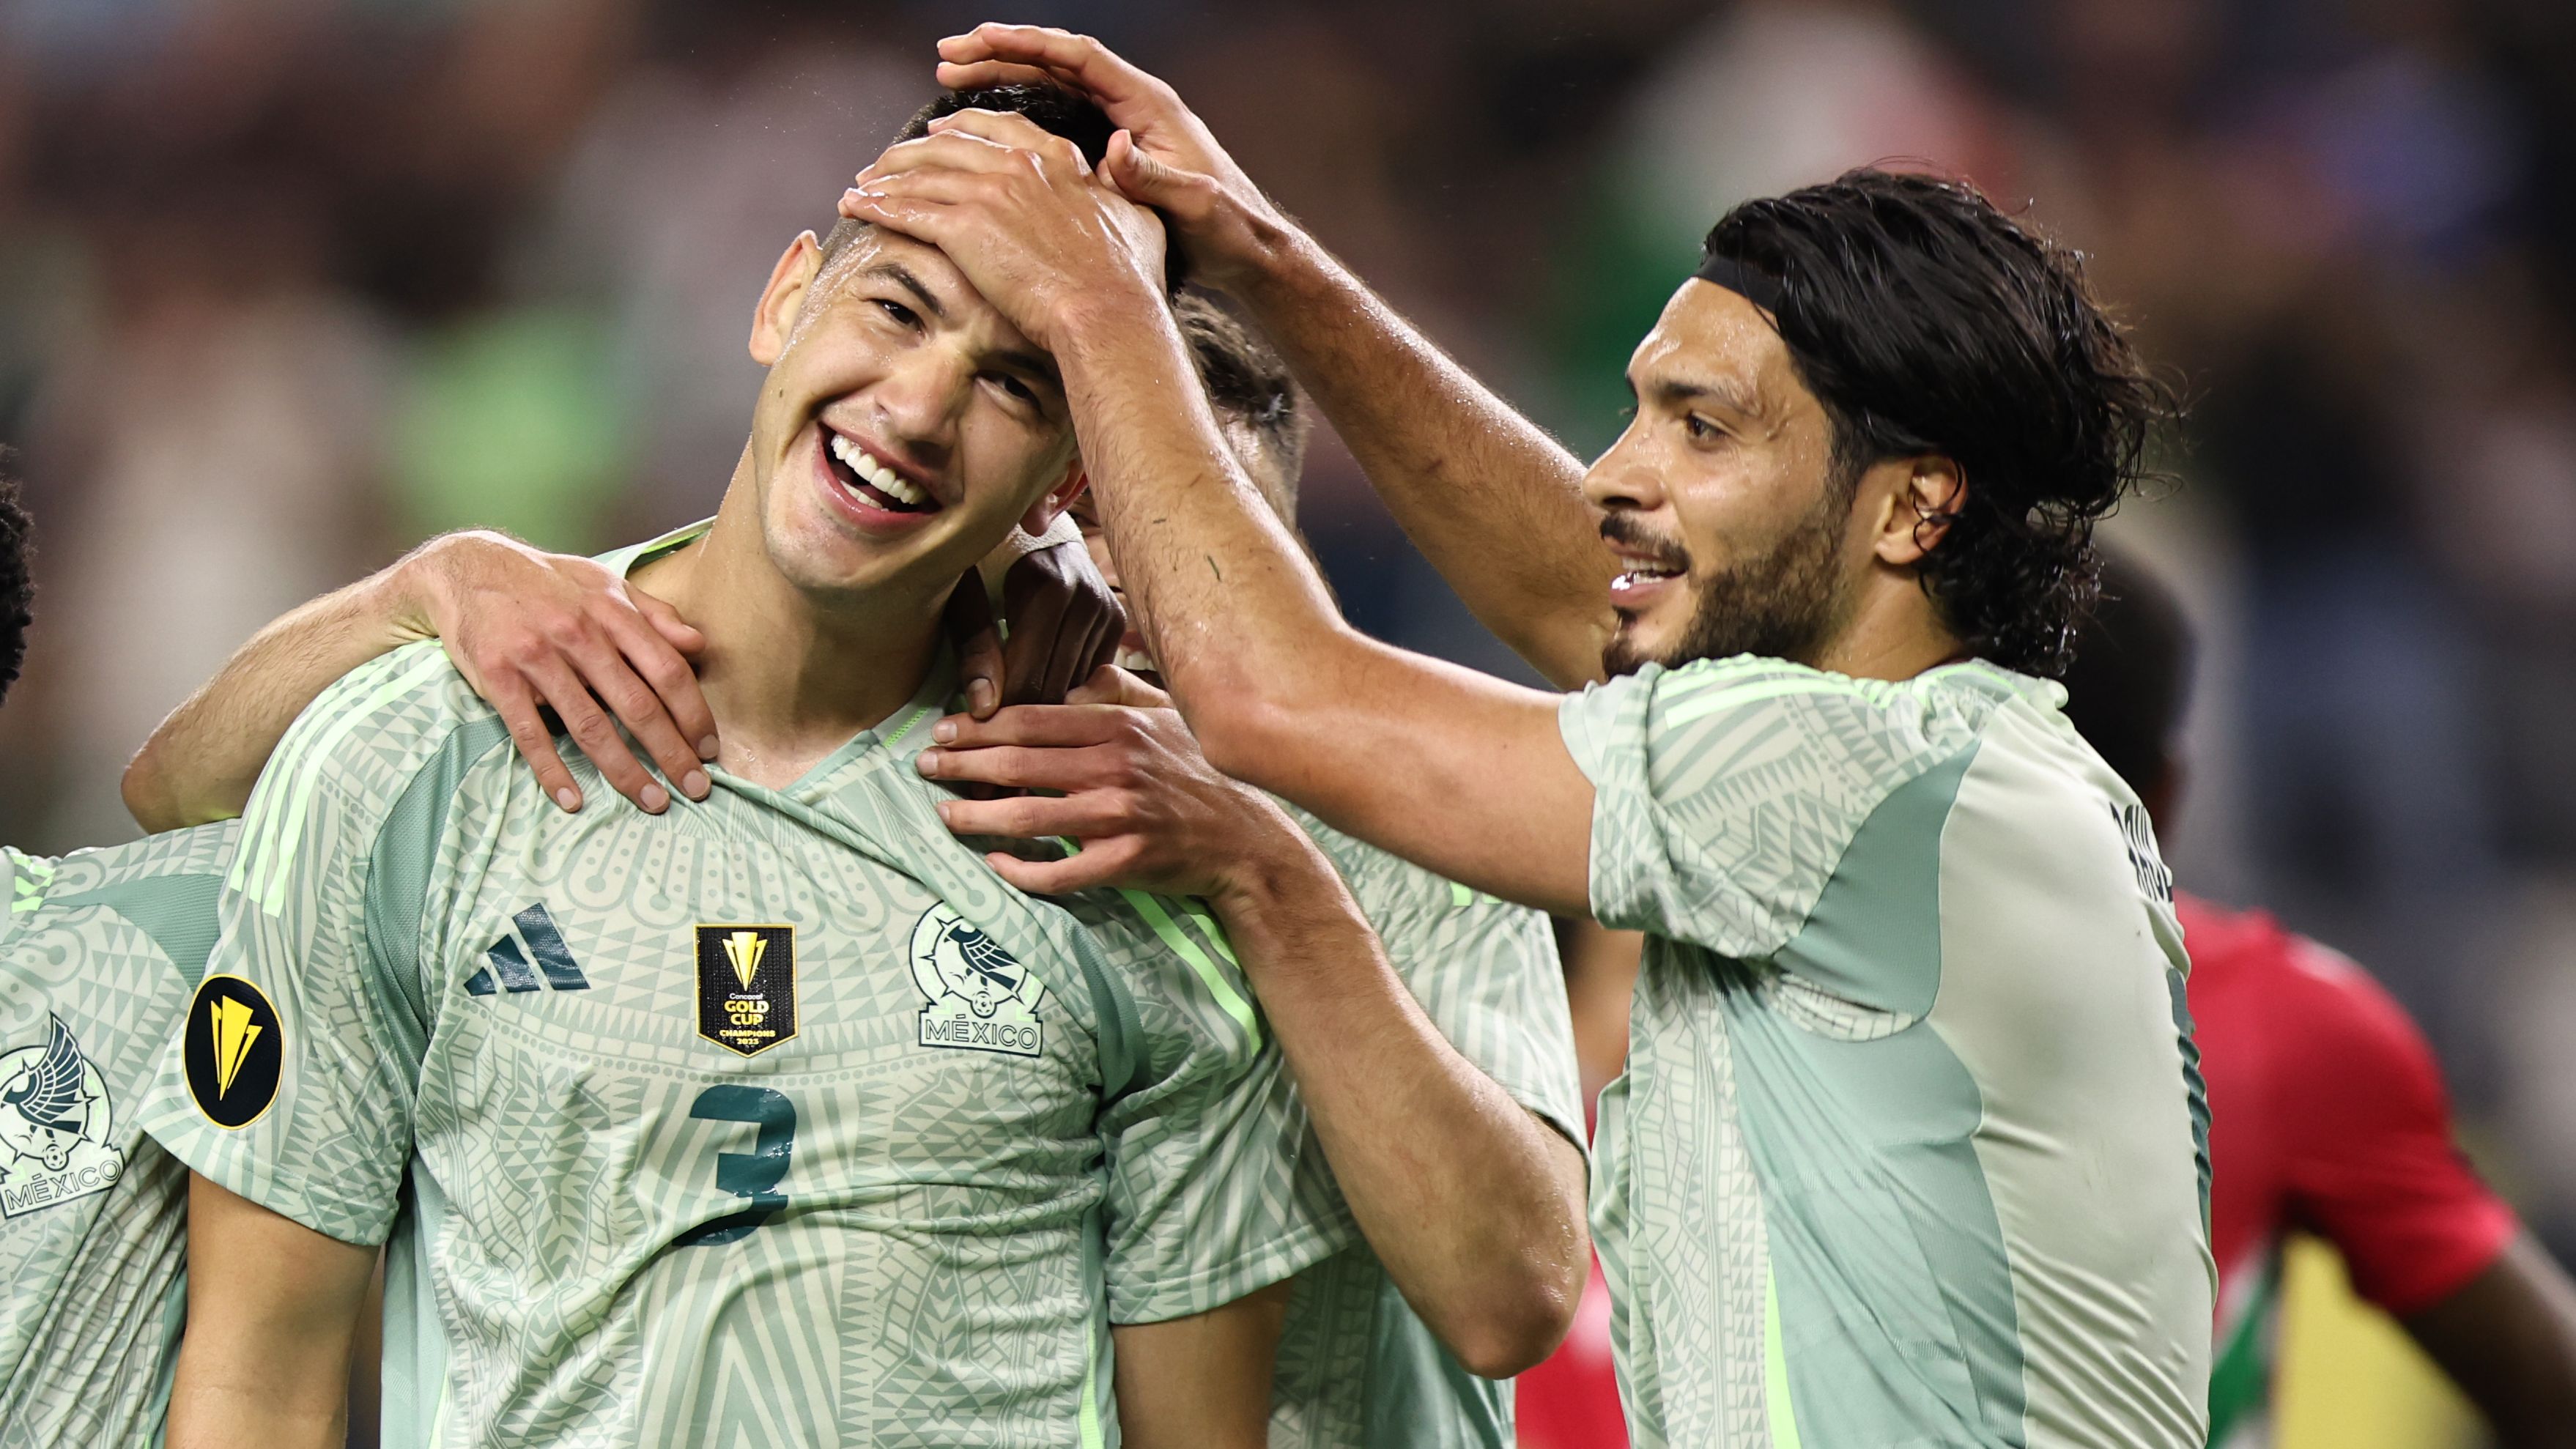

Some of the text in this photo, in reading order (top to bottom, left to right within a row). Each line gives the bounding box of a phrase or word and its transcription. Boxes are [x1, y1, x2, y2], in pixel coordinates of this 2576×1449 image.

[724, 1000, 769, 1013] GOLD
[730, 1013, 764, 1026] CUP
[925, 1013, 1038, 1050] MÉXICO
[719, 1029, 776, 1037] CHAMPIONS
[671, 1083, 797, 1246] 3
[4, 1160, 121, 1210] MÉXICO
